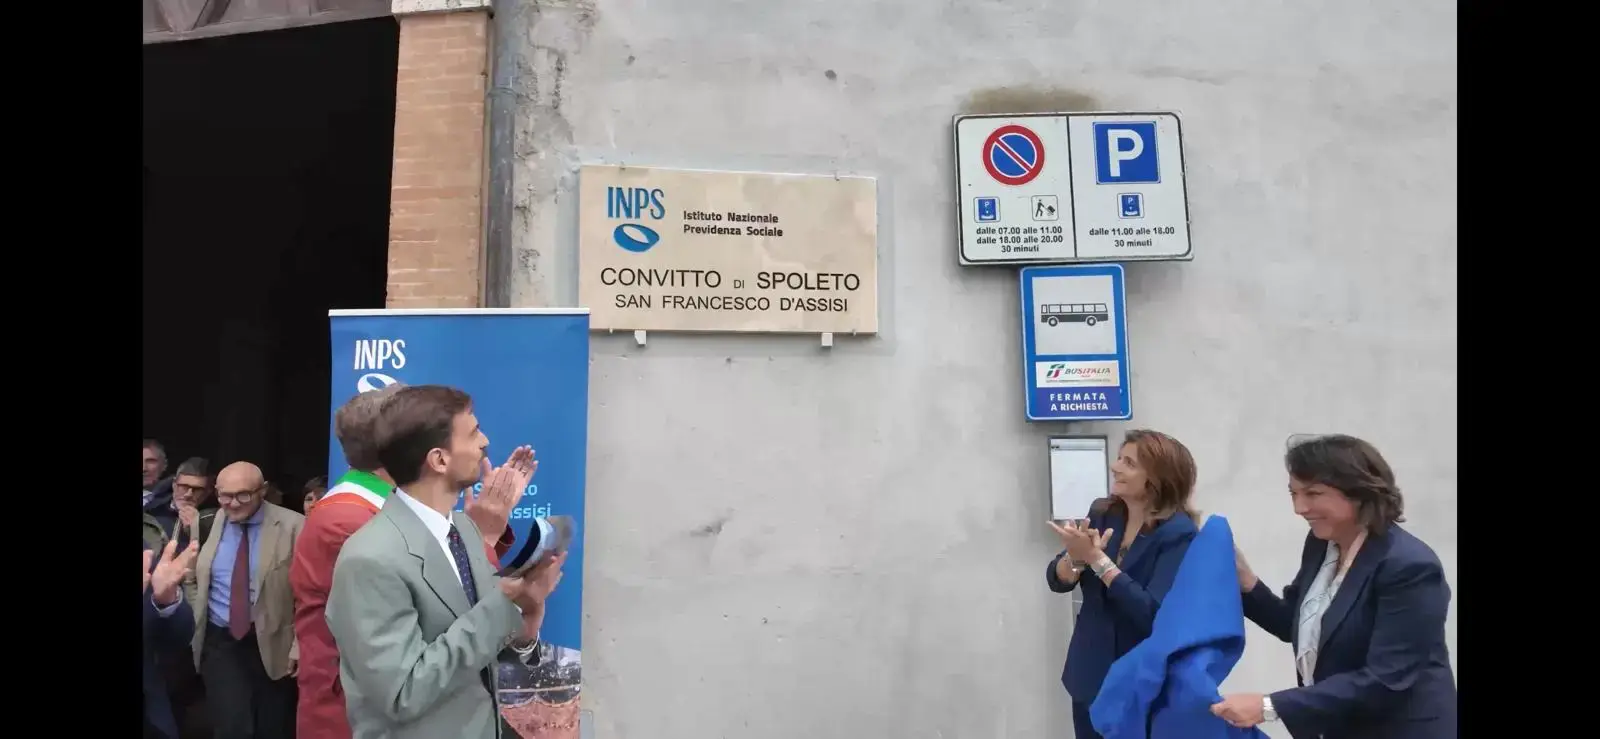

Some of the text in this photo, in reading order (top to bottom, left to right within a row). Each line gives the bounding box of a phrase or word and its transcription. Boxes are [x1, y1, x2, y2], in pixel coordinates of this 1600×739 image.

[1107, 128, 1144, 177] P
[607, 186, 665, 220] INPS
[683, 210, 779, 223] Istituto Nazionale
[683, 224, 783, 237] Previdenza Sociale
[976, 226, 1062, 235] dalle 07.00 alle 11.00
[1089, 227, 1175, 236] dalle 11.00 alle 18.00
[976, 236, 996, 244] dalle
[999, 236, 1021, 244] 18.00
[1041, 235, 1063, 243] 20.00
[1114, 238, 1152, 247] 30 minuti
[1001, 244, 1039, 253] 30 minuti
[600, 267, 860, 291] CONVITTO DI SPOLETO
[615, 294, 848, 312] SAN FRANCESCO D'ASSISI
[354, 339, 406, 370] INPS
[1064, 367, 1111, 375] BUSITALIA
[1050, 392, 1106, 401] FERMATA
[1050, 402, 1109, 411] A RICHIESTA
[509, 503, 551, 520] ssisi
